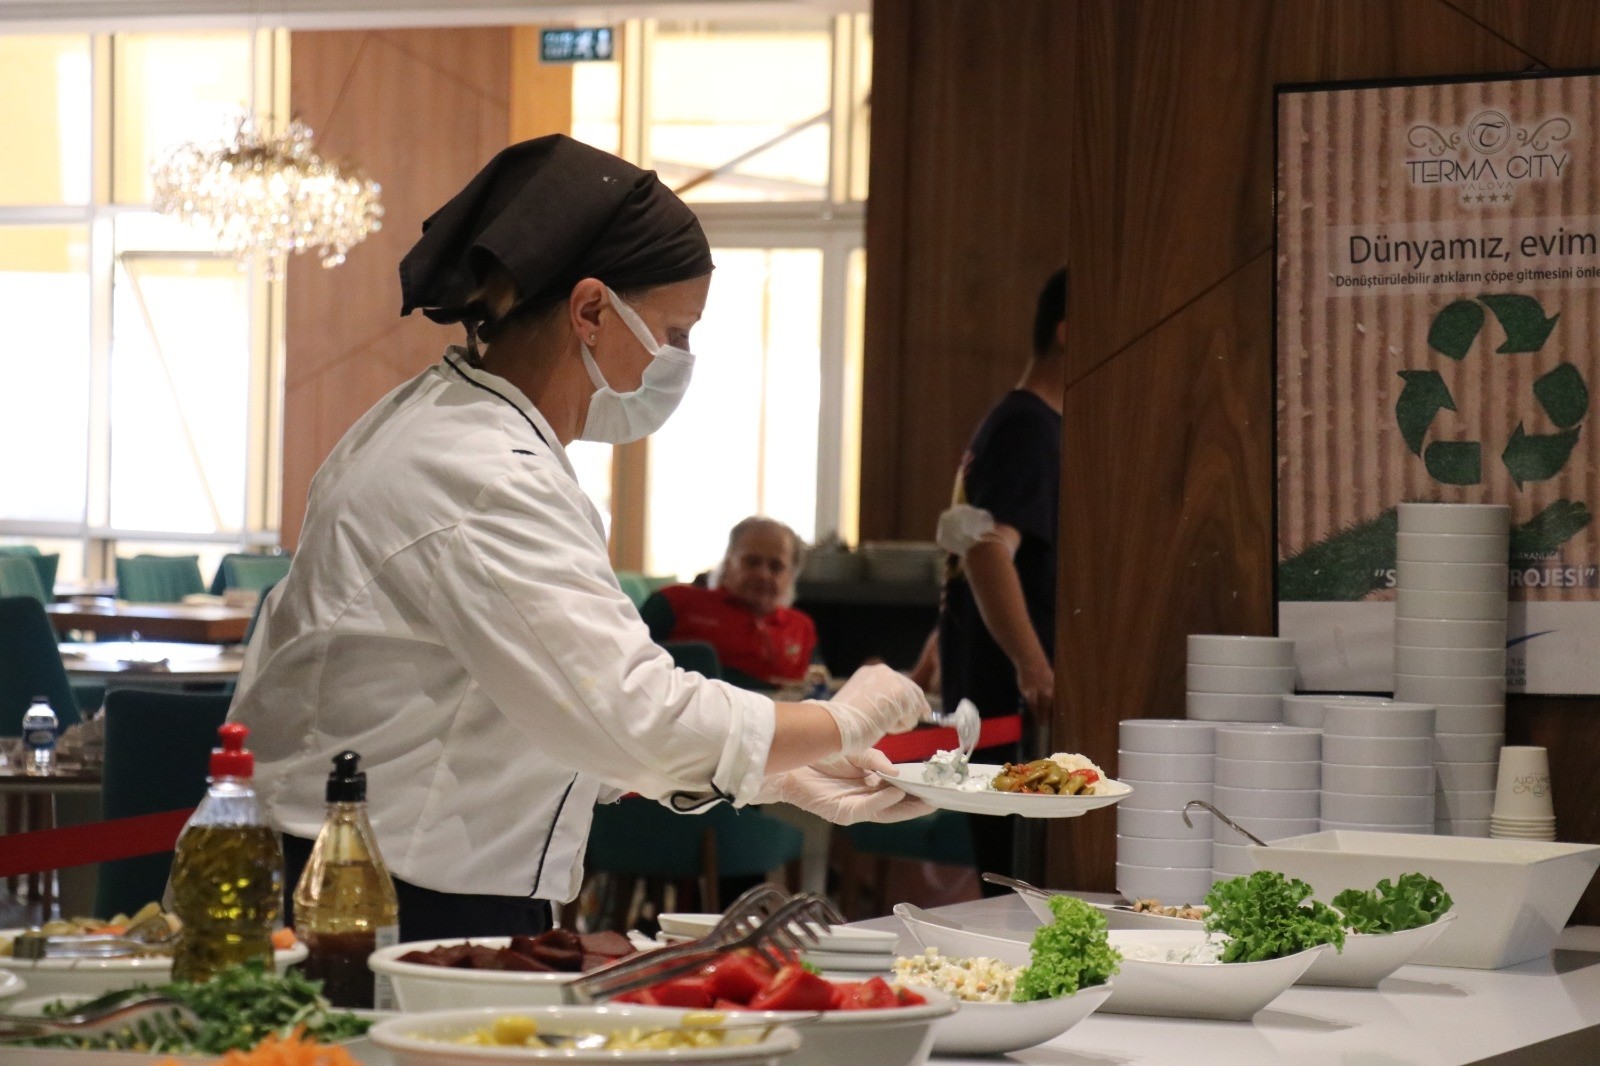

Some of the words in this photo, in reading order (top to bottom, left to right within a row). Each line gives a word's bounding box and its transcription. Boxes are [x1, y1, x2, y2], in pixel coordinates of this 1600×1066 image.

[1406, 159, 1498, 183] TERMA
[1506, 154, 1567, 179] CITY
[1461, 181, 1514, 191] YALOVA
[1349, 234, 1511, 269] Dünyamız,
[1336, 271, 1431, 288] Dönüştürülebilir
[1433, 271, 1482, 285] atıkların
[1485, 270, 1514, 285] çöpe
[1517, 266, 1573, 284] gitmesini
[1509, 564, 1596, 587] ROJESİ"
